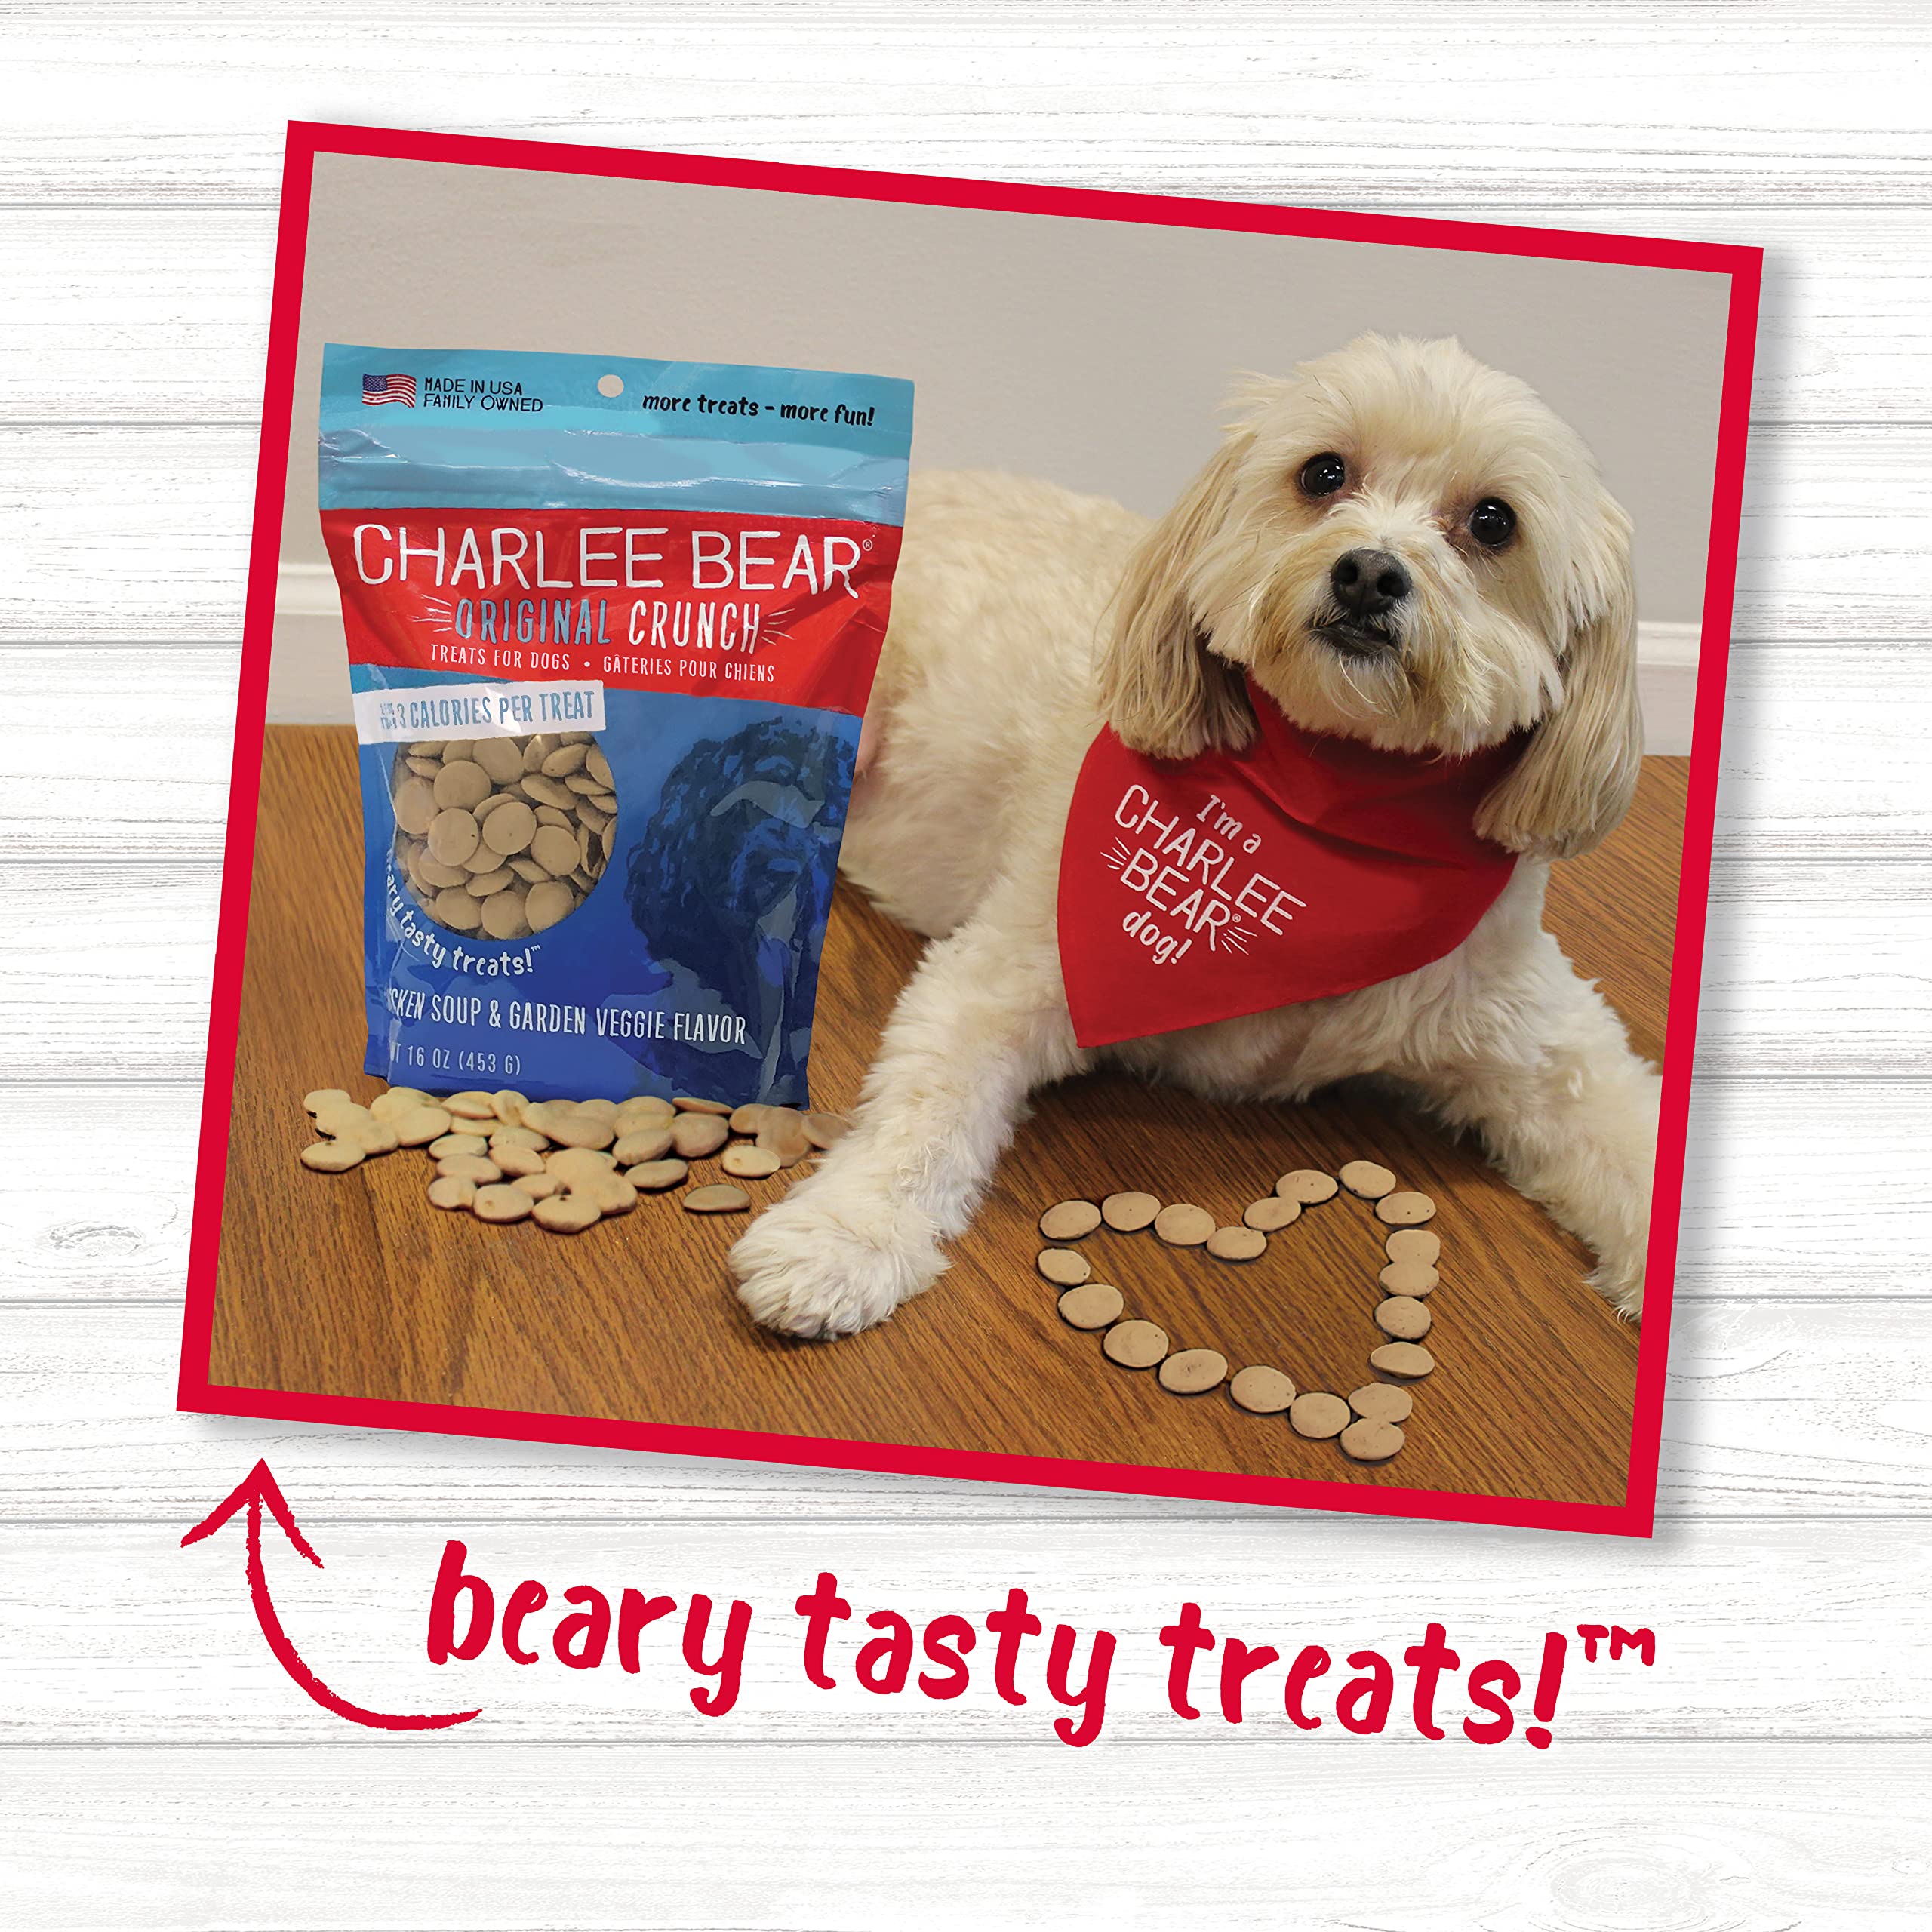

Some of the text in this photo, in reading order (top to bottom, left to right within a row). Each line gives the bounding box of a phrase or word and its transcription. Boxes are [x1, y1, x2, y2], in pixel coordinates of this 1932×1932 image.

[423, 393, 543, 412] FAMILY OWNED
[424, 377, 522, 395] MADE IN USA
[642, 395, 691, 411] more
[697, 394, 759, 416] treats
[780, 403, 829, 422] more
[834, 404, 875, 426] fun!
[353, 524, 669, 589] CHARLEE
[455, 598, 760, 654] ORIGINAL CRUNCH
[430, 644, 486, 665] TREATS
[494, 650, 522, 668] FOR
[531, 652, 571, 670] DOGS
[603, 654, 672, 676] GÂTERIES
[679, 660, 717, 679] POUR
[724, 664, 776, 683] CHIENS
[410, 697, 492, 729] CALORIES
[499, 694, 534, 724] PER
[539, 690, 595, 721] TREAT
[1196, 795, 1262, 854] I'm a
[1115, 784, 1307, 936] CHARLEE
[401, 910, 447, 968] tasty
[1122, 910, 1192, 964] dog!
[431, 994, 481, 1026] SOUP
[488, 999, 502, 1029] &
[509, 1001, 586, 1035] GARDEN
[596, 1008, 665, 1038] VEGGIE
[674, 1012, 746, 1044] FLAVOR
[408, 1045, 425, 1066] 16
[432, 1048, 451, 1069] OZ
[458, 1051, 496, 1072] (453
[504, 1054, 521, 1075] G)
